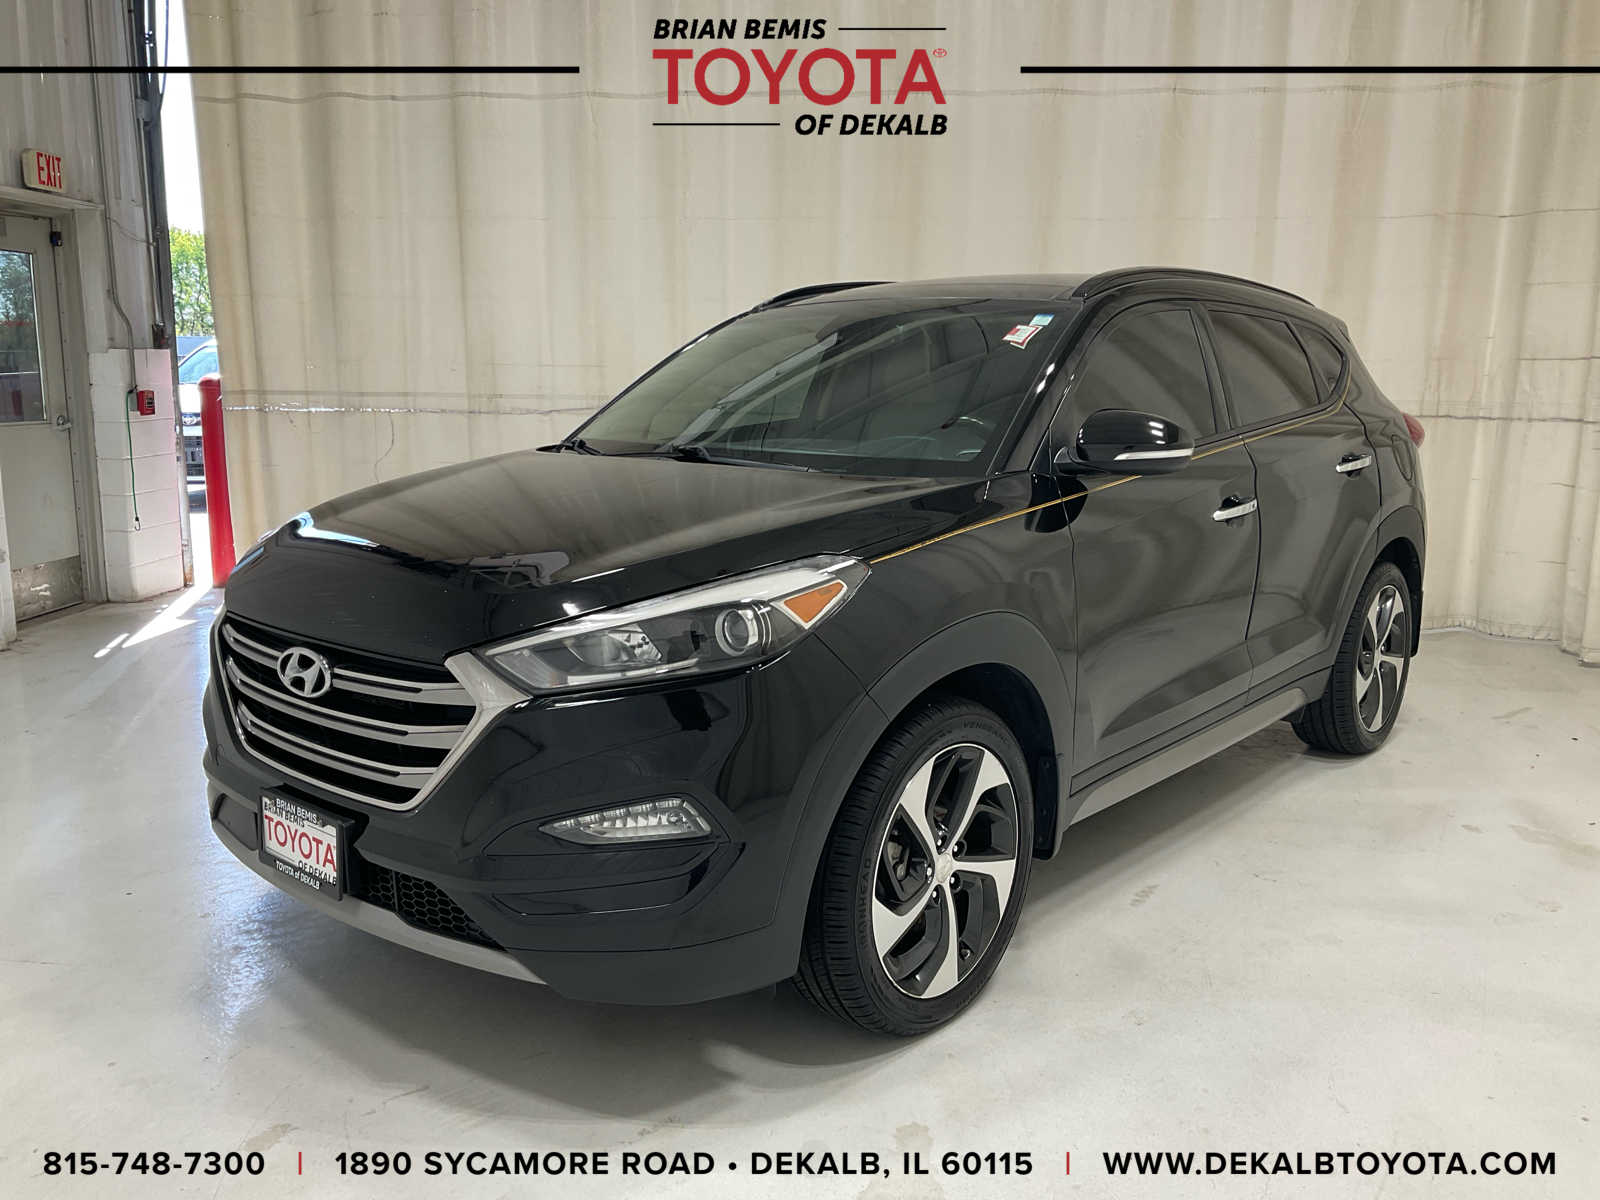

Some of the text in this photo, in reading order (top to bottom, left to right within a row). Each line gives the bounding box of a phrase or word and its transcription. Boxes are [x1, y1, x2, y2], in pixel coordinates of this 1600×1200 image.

[36, 151, 63, 190] EXIT
[276, 798, 317, 824] BRIAN BEMIS
[264, 814, 337, 873] TOYOTA
[276, 861, 294, 877] TOYOTA
[300, 873, 321, 890] DEKALB
